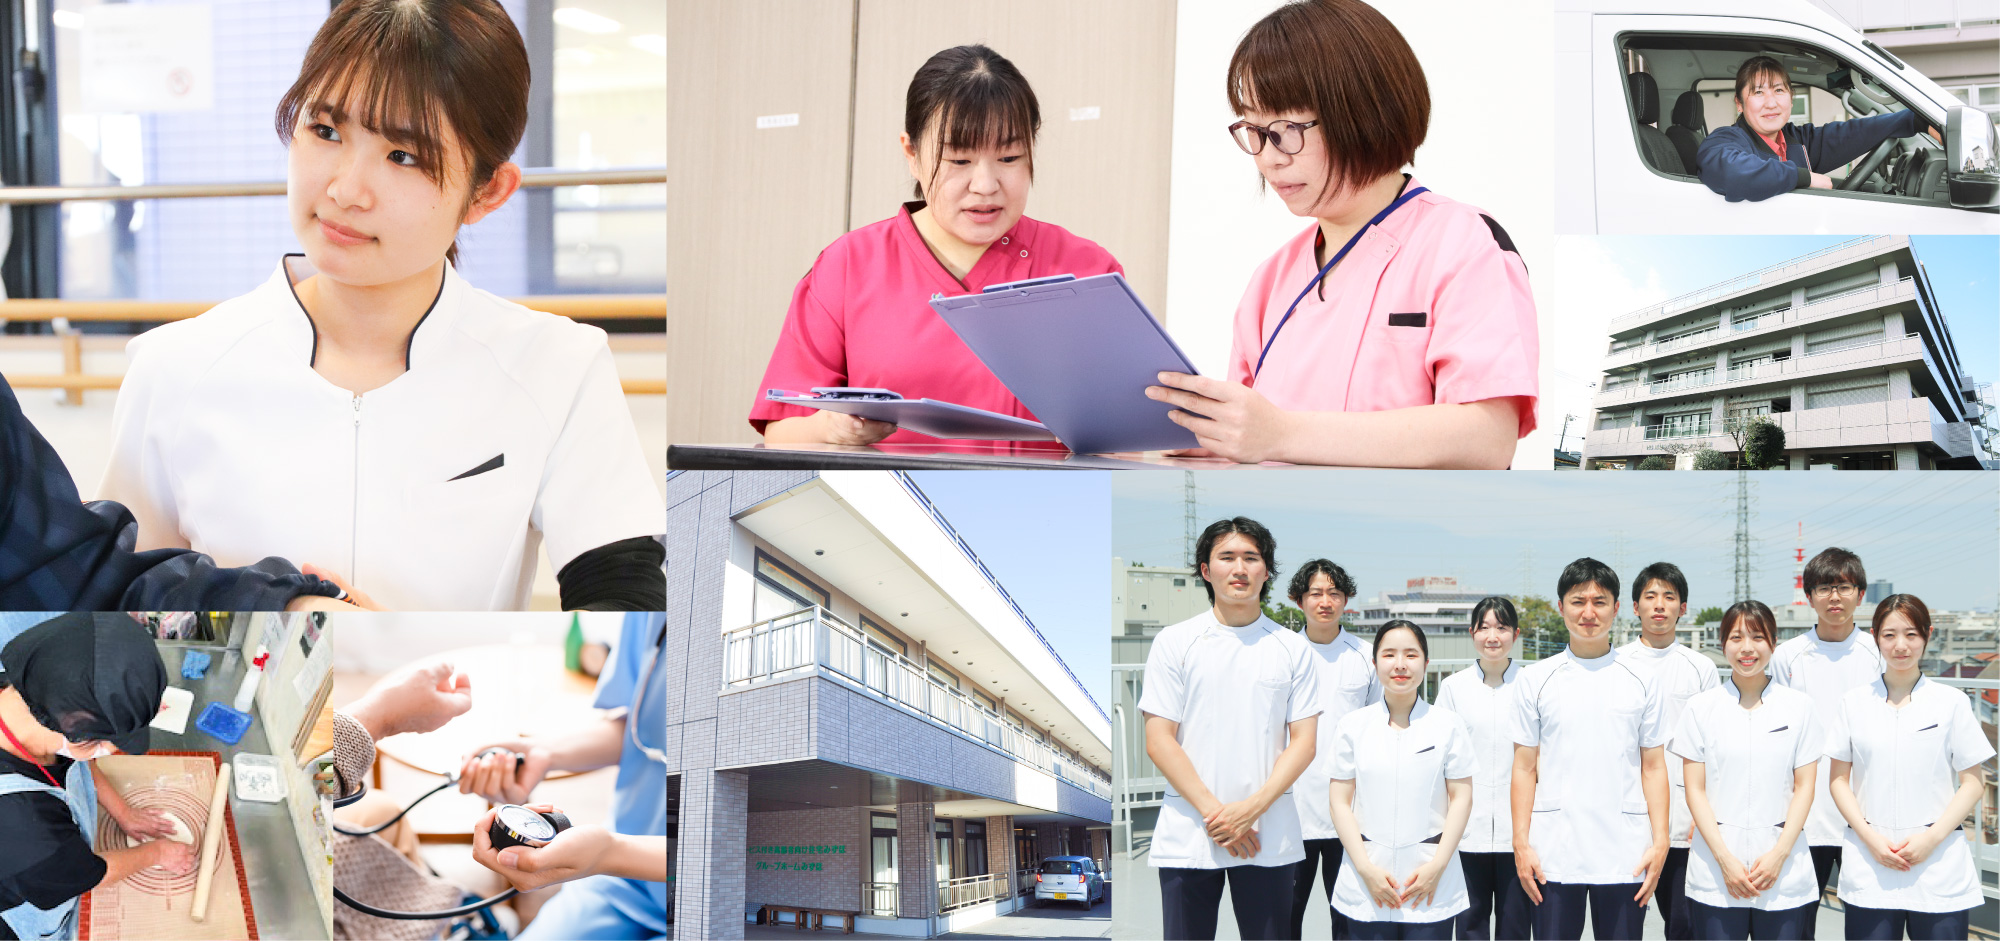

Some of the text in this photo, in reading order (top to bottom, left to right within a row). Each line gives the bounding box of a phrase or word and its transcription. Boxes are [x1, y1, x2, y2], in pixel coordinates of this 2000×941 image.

[755, 861, 823, 871] グループホームみずほ
